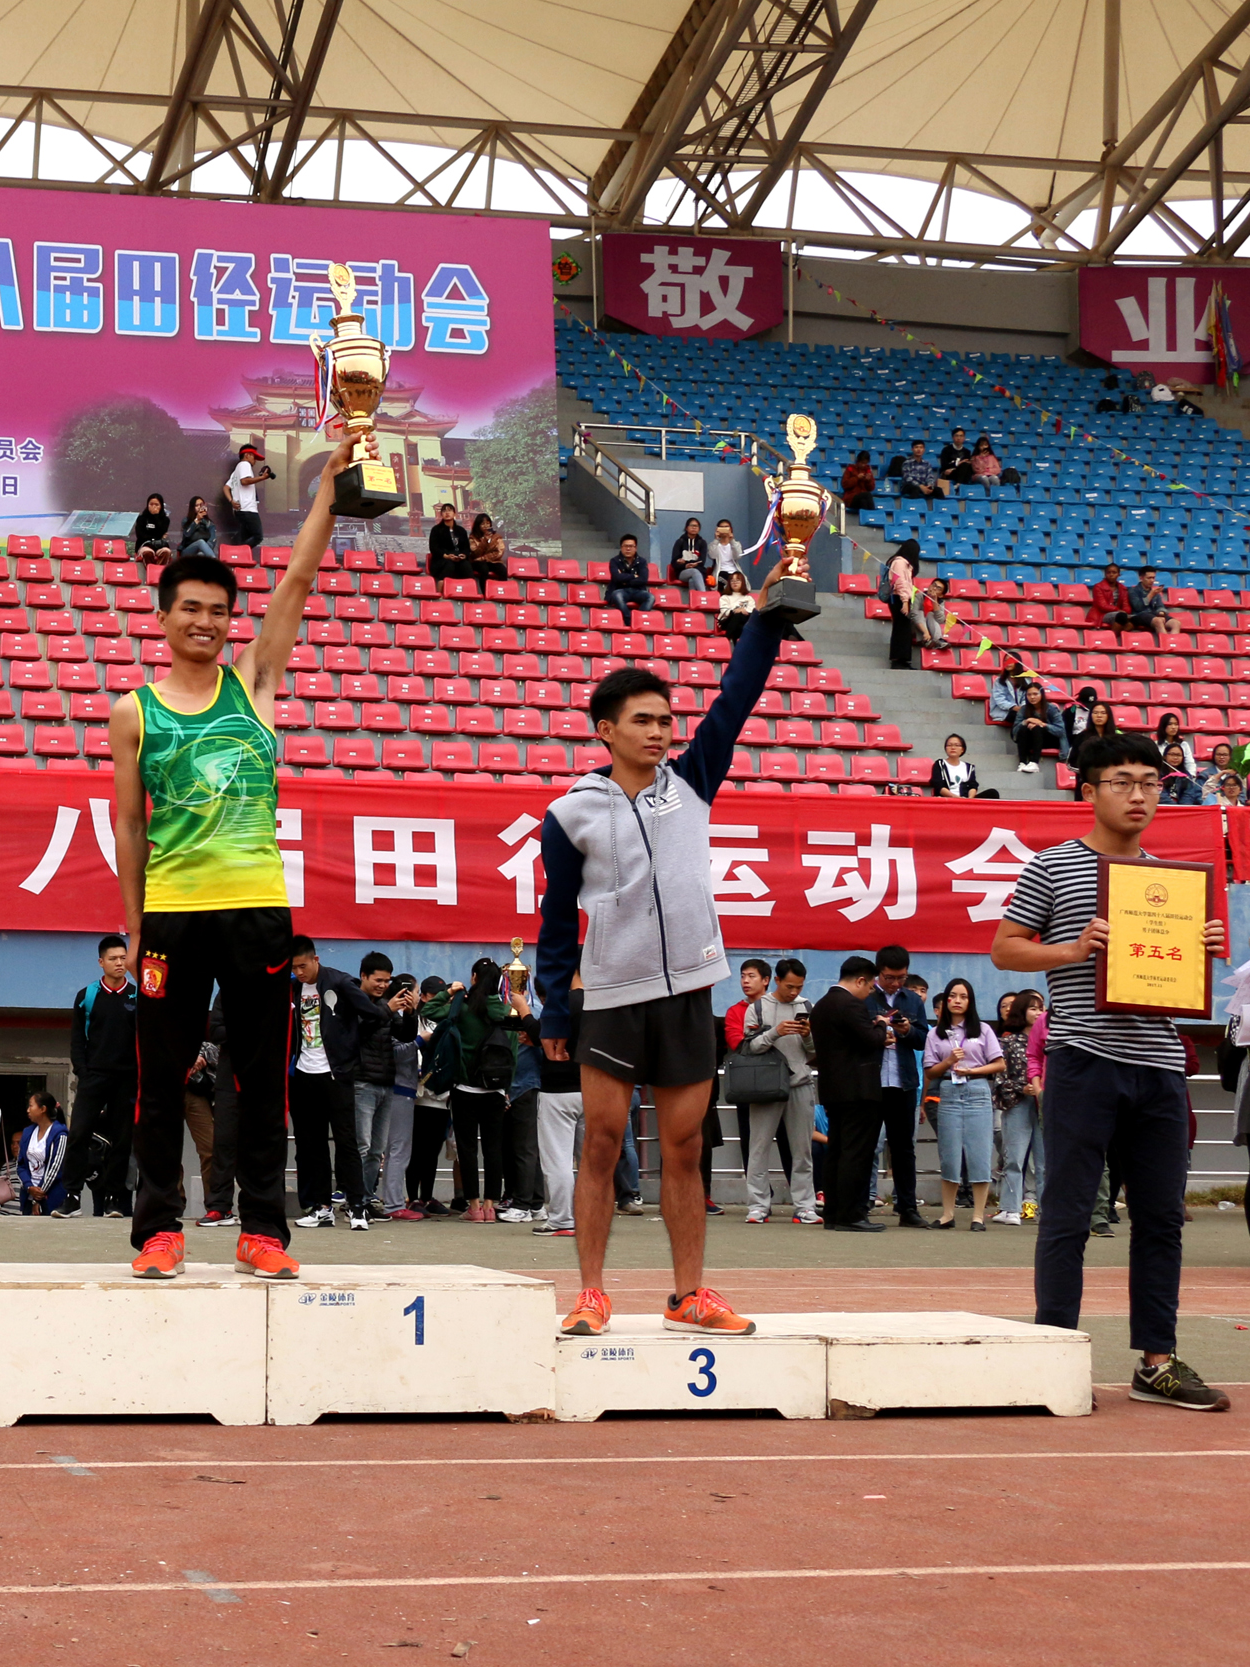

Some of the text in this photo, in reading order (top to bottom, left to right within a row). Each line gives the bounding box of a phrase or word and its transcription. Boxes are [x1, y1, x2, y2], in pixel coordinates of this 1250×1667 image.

[639, 245, 755, 332] 敬
[1111, 277, 1217, 363] 业
[1129, 942, 1183, 961] 第五名
[403, 1296, 425, 1345] 1
[687, 1348, 717, 1397] 3
